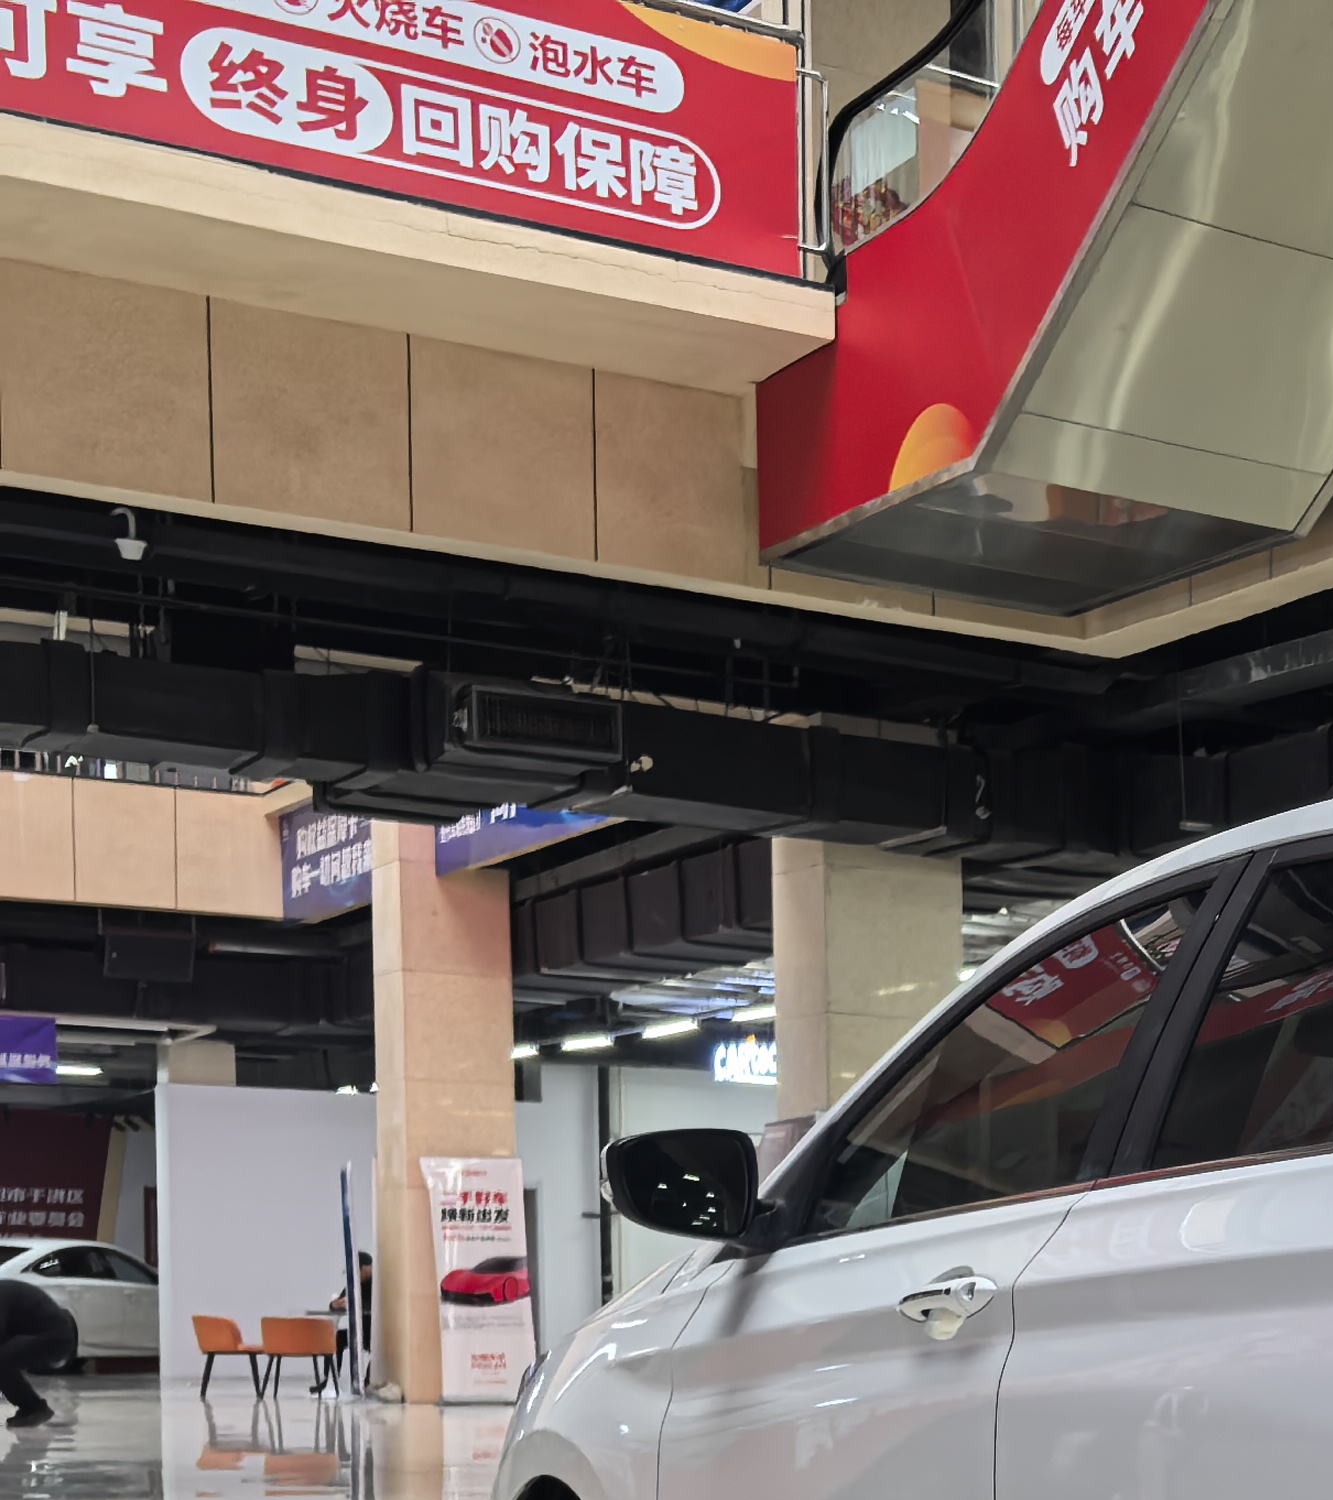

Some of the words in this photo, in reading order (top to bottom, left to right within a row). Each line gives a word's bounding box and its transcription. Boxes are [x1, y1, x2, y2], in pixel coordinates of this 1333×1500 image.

[527, 31, 659, 98] 泡水车
[206, 41, 370, 140] 终身
[400, 82, 699, 216] 回购保障
